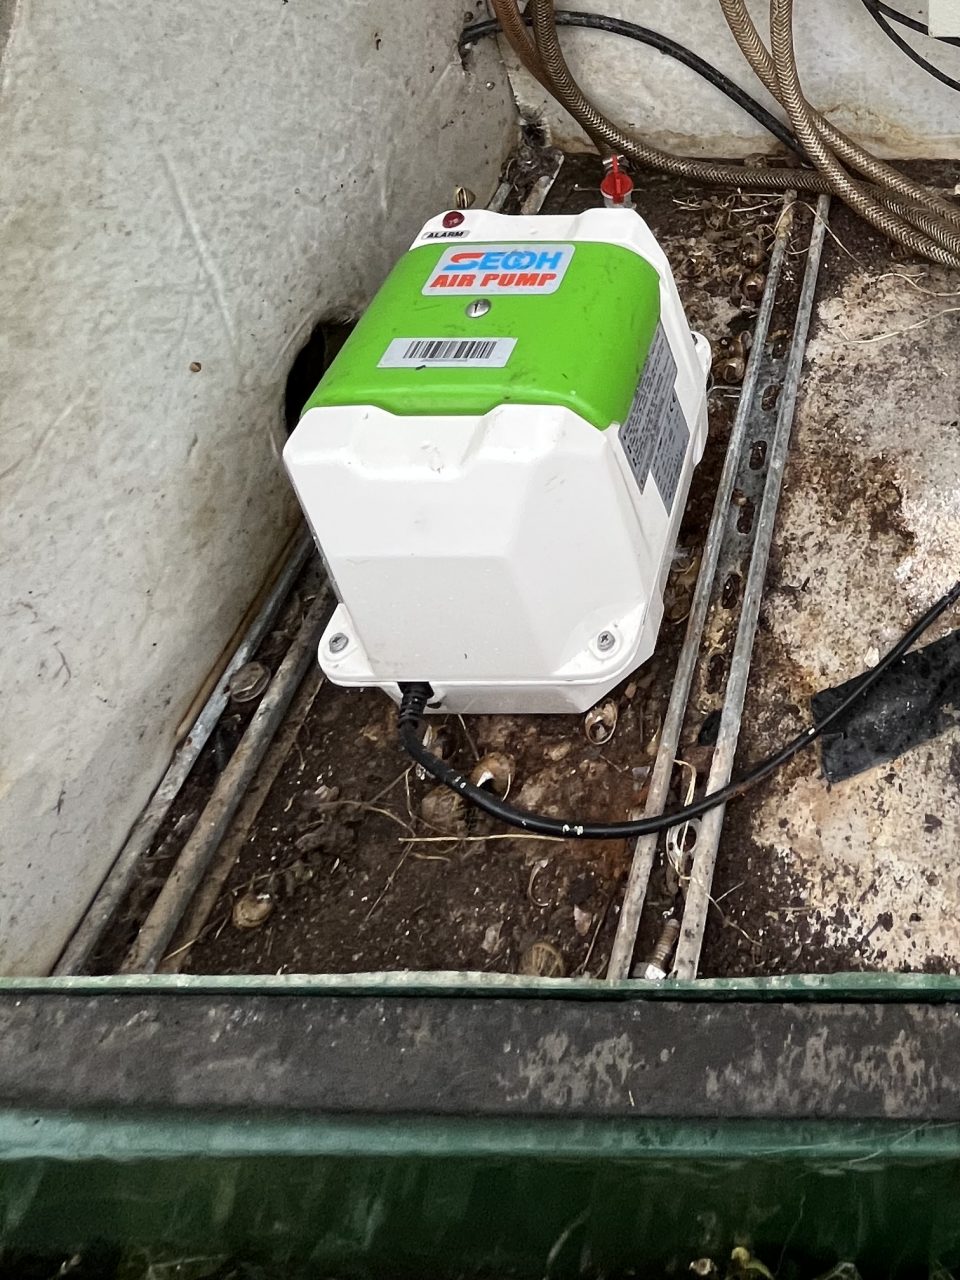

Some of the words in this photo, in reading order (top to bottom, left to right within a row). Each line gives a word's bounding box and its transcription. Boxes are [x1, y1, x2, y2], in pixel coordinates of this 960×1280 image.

[426, 230, 464, 239] ALARM
[429, 274, 477, 288] AIR
[480, 273, 557, 287] PUMP
